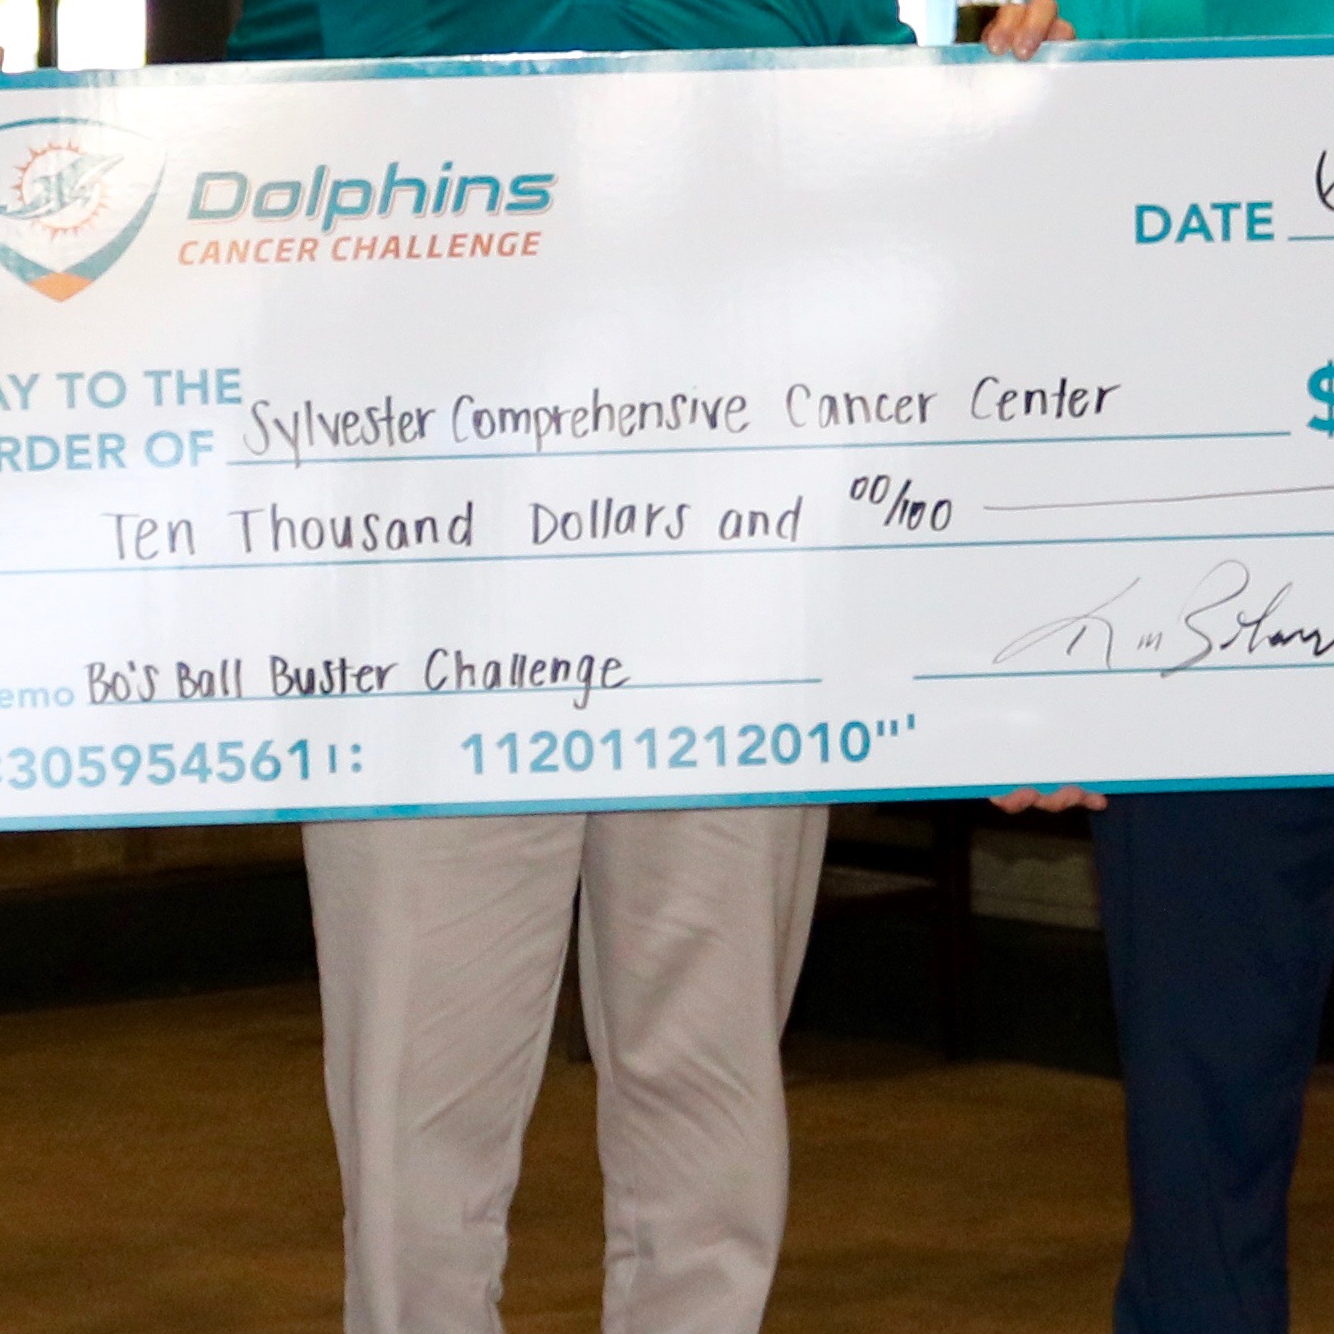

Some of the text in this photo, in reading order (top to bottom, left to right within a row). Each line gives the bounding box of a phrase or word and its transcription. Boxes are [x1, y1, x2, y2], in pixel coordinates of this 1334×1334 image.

[187, 160, 559, 234] Dolphins
[1134, 200, 1275, 245] DATE
[178, 231, 543, 266] CANCER CHALLENGE
[55, 370, 127, 409] TO
[143, 367, 242, 407] THE
[144, 429, 214, 467] OF
[242, 375, 1121, 469] Sylvester Comprehensive Cancer Center
[99, 510, 196, 562] Ten
[226, 499, 473, 553] Thousand
[528, 496, 692, 547] Dollars
[718, 494, 804, 543] and
[84, 646, 631, 710] Bo's Ball Buster Challenge
